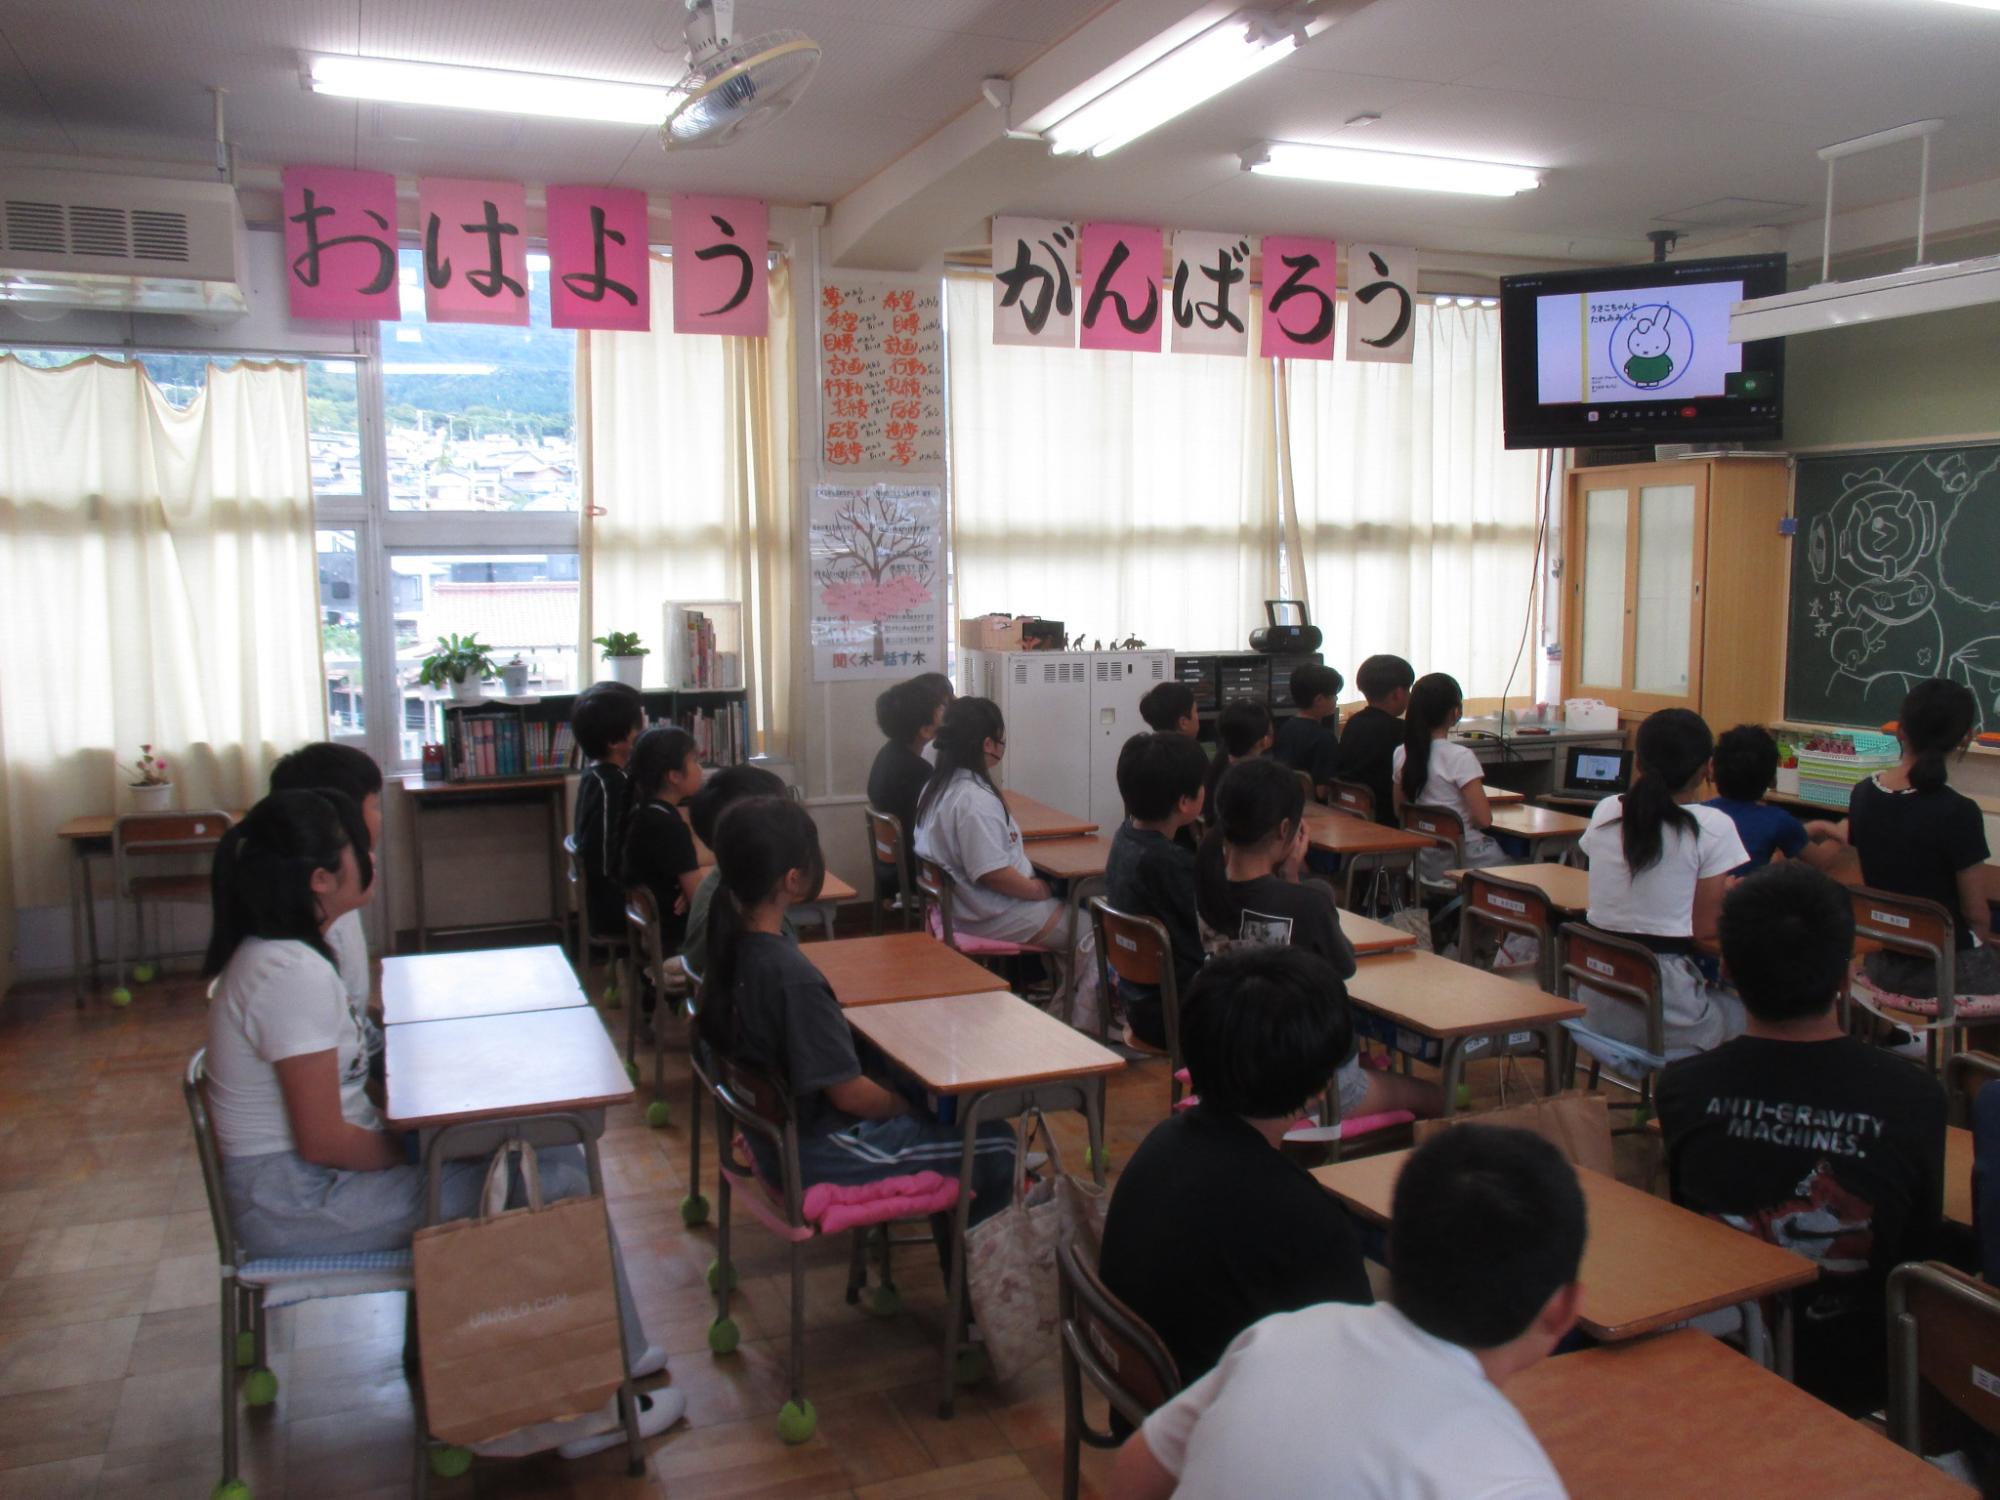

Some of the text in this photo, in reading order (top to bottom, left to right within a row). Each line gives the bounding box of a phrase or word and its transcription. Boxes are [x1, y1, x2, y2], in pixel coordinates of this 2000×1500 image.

[289, 188, 754, 317] おはよう
[995, 225, 1412, 348] がんばろう
[1591, 303, 1637, 313] うさこちゃんと
[1706, 1097, 1886, 1139] ANTI-GRAVITY
